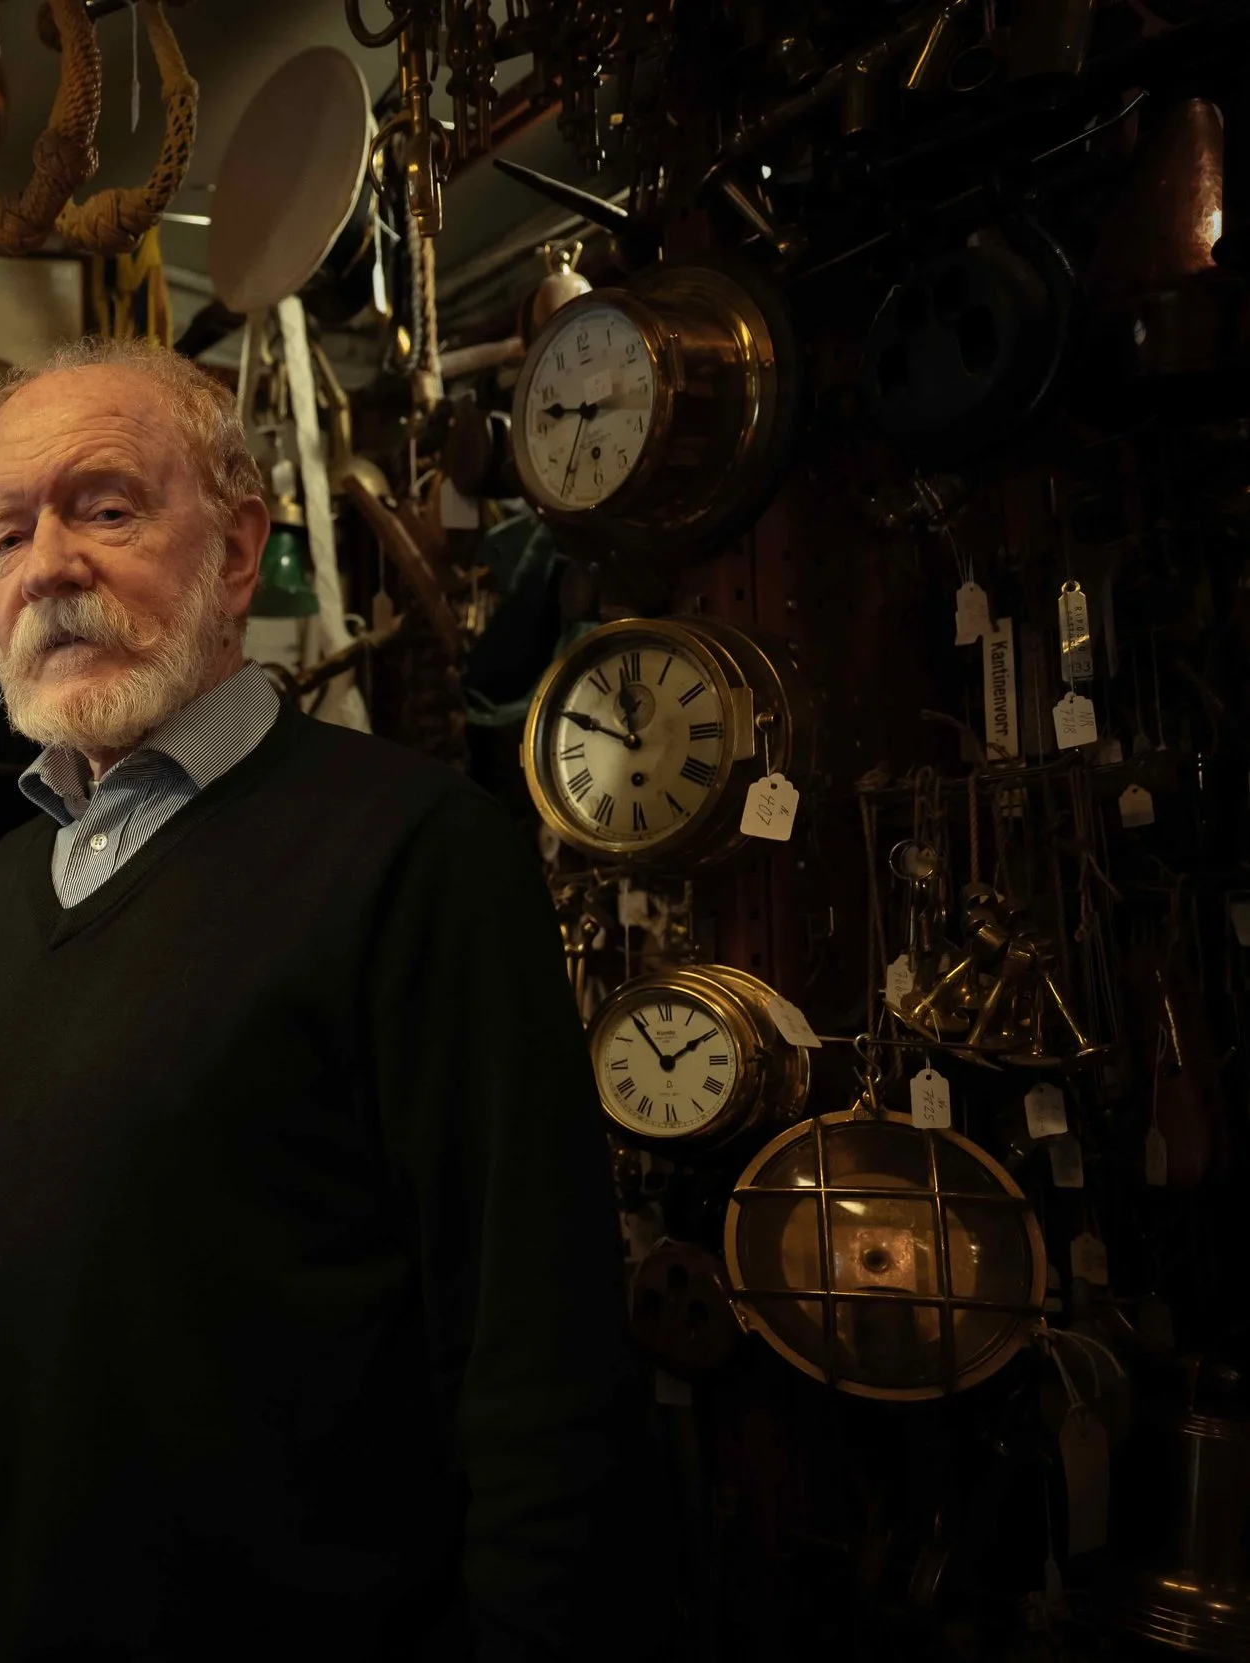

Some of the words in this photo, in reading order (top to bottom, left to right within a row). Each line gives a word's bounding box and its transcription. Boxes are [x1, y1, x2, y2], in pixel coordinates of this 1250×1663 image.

[577, 331, 590, 352] 12
[557, 352, 565, 372] 11
[625, 344, 638, 365] 2
[593, 468, 604, 487] 6
[622, 652, 641, 682] XII
[678, 682, 706, 707] II
[756, 793, 776, 826] 407
[657, 1004, 672, 1022] XII
